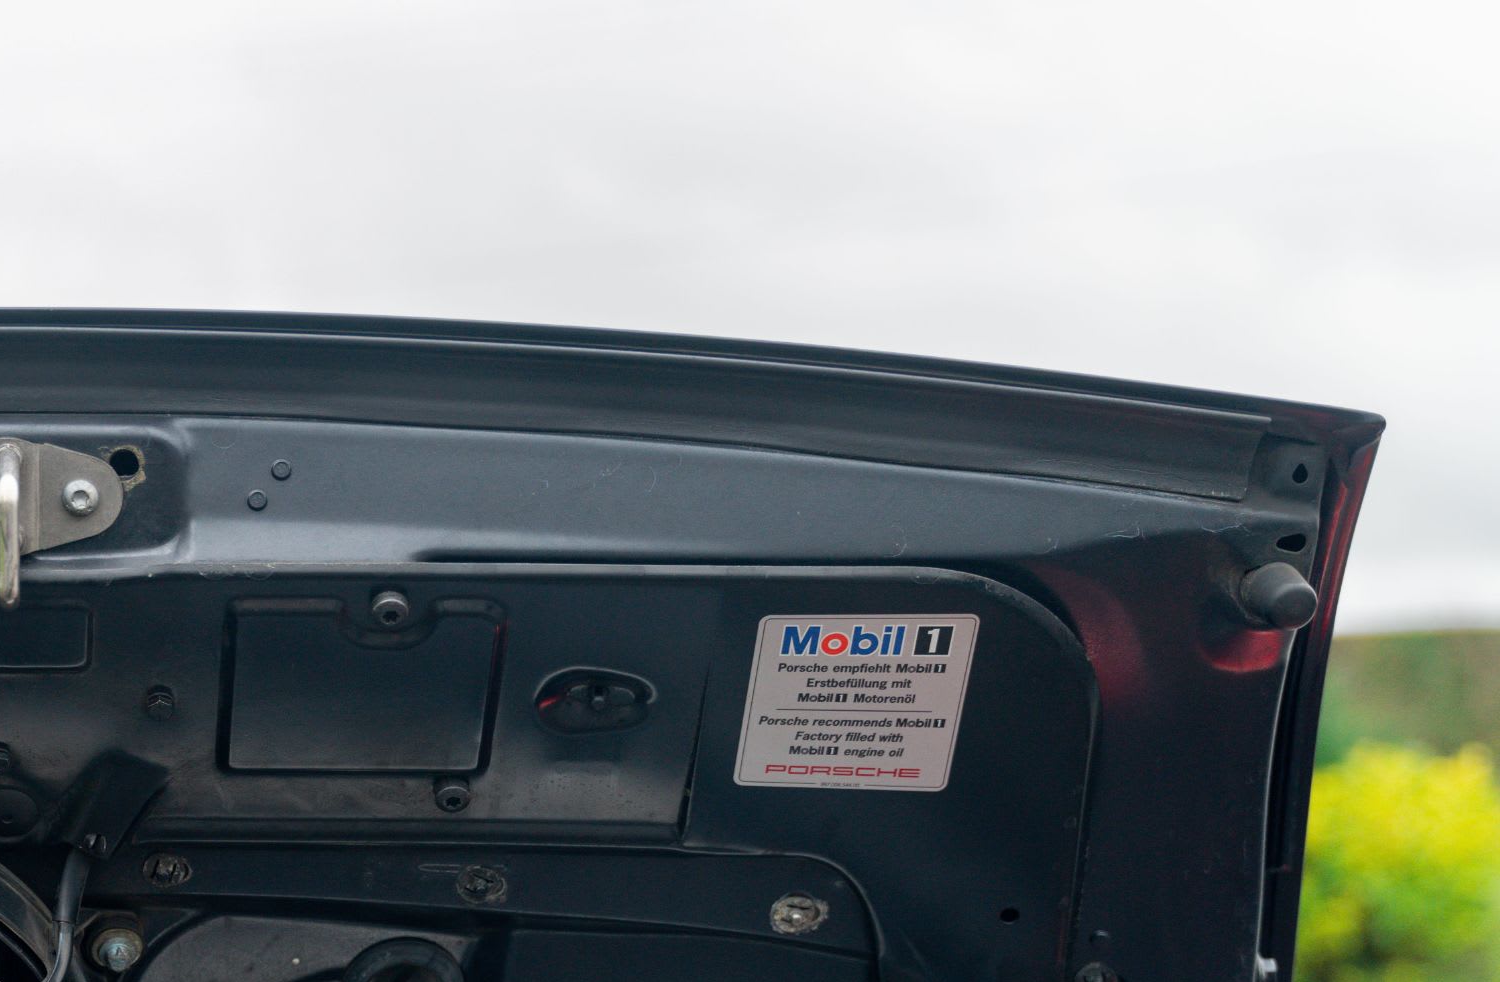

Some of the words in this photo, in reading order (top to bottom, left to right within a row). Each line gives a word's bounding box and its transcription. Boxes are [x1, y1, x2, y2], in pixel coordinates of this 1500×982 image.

[780, 625, 906, 656] Mobil
[777, 662, 829, 673] Porsche
[832, 663, 892, 675] empfiehlt
[806, 677, 887, 690] Erstbefüllung
[891, 678, 912, 689] mit
[853, 693, 916, 704] Motorenöl
[758, 715, 810, 726] Porsche
[812, 717, 893, 728] recommends
[794, 731, 842, 743] Factory
[845, 732, 876, 742] filled
[878, 733, 904, 743] with
[843, 747, 885, 758] engine
[888, 748, 904, 757] oil
[764, 764, 921, 779] PORSCHE
